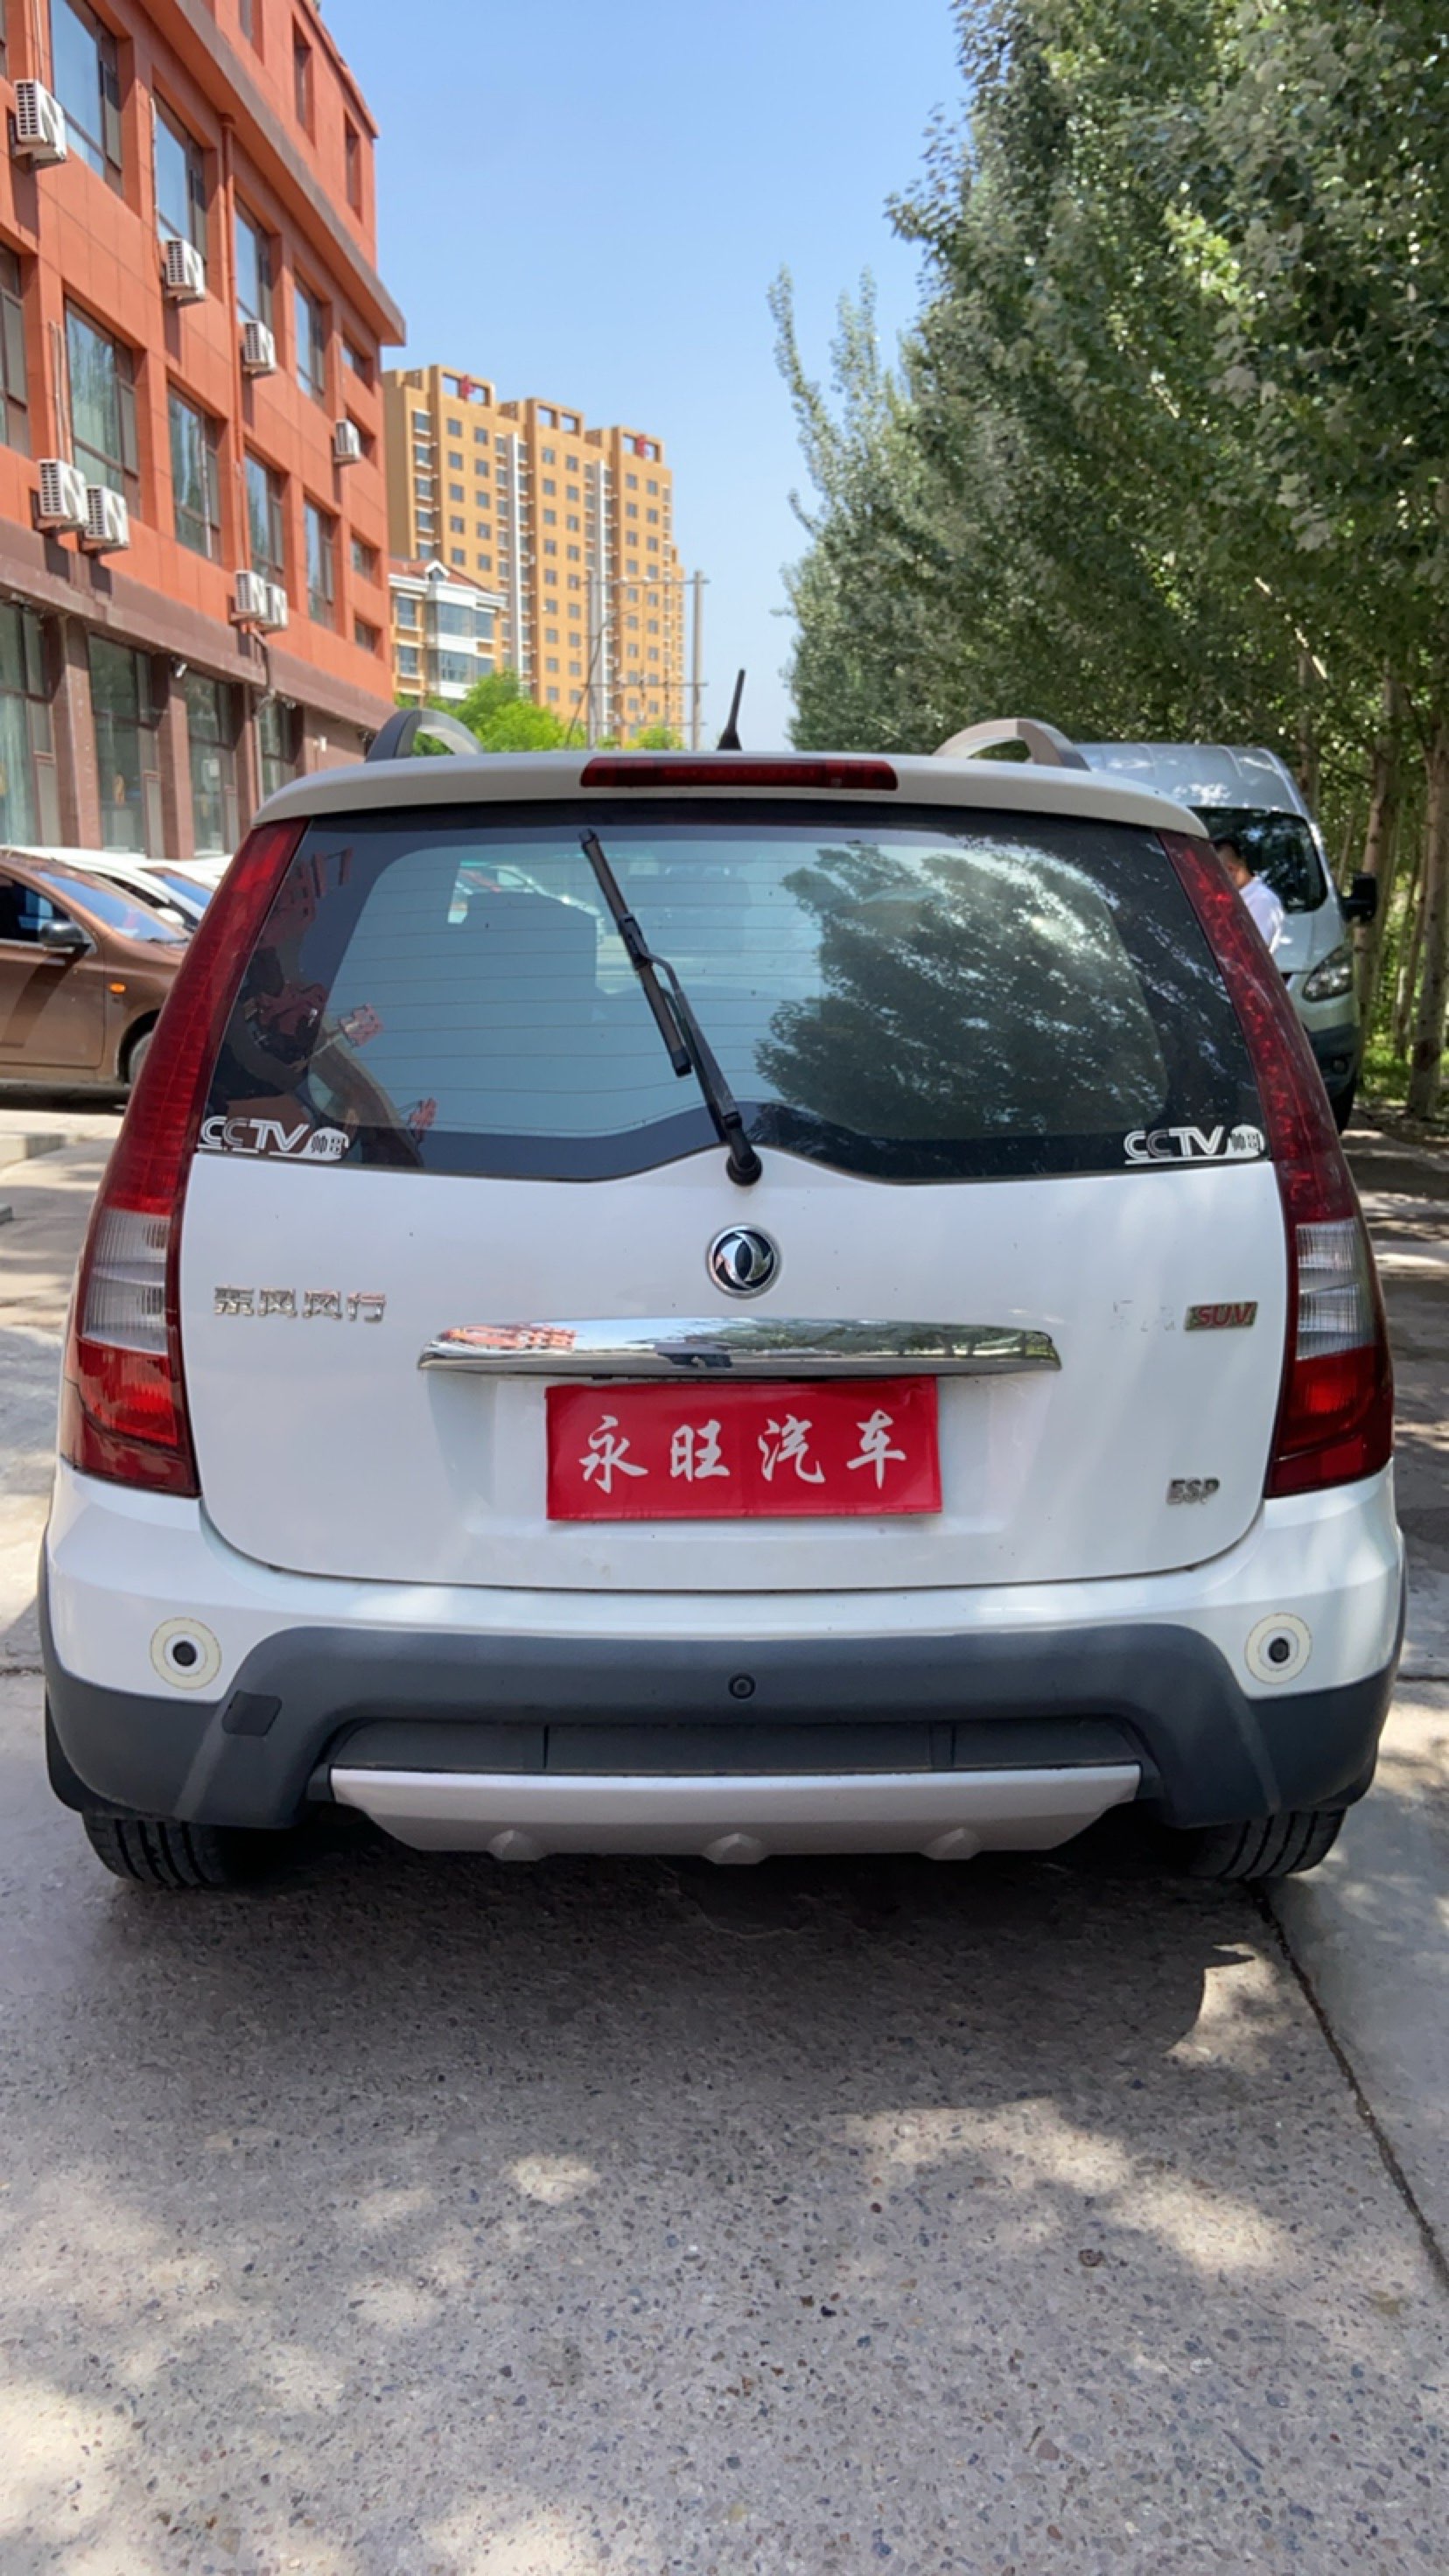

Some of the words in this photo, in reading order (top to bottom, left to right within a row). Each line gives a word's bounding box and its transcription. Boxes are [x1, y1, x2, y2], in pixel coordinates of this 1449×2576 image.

[200, 1116, 309, 1152] CCTV
[1124, 1125, 1224, 1158] CCTV
[1195, 1304, 1254, 1327] SUV
[578, 1408, 906, 1494] 永旺汽车
[1166, 1477, 1220, 1505] ESP
